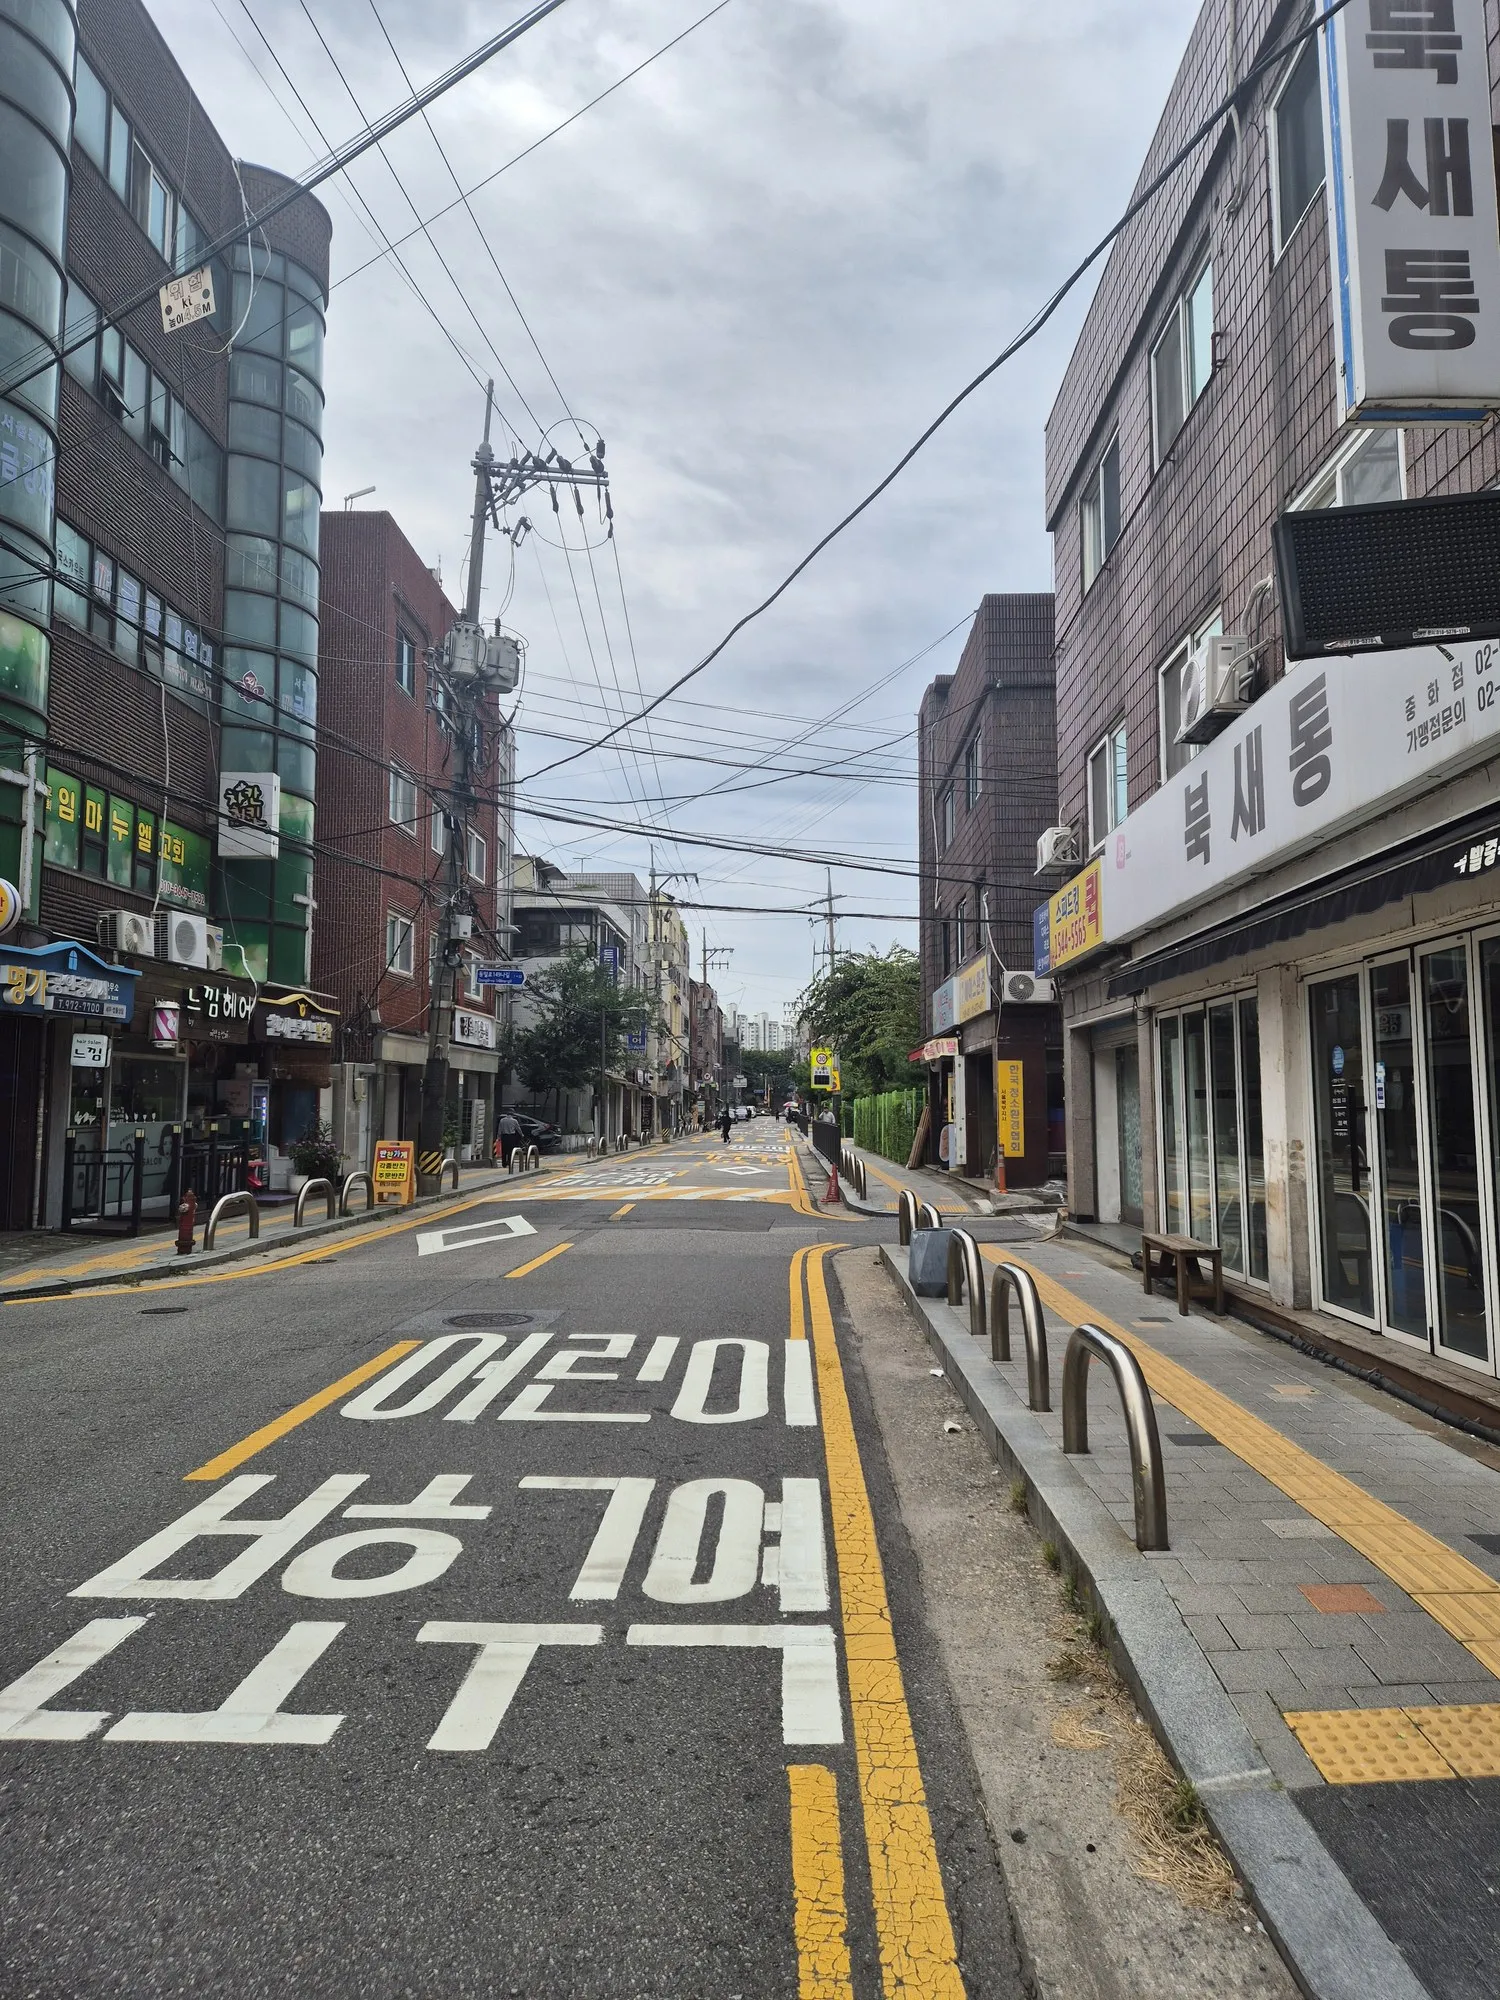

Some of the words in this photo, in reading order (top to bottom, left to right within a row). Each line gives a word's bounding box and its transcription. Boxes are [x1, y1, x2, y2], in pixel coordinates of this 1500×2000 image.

[1365, 0, 1480, 351] 북새통
[170, 272, 203, 300] 위험
[1405, 661, 1464, 721] 중화점
[1406, 697, 1466, 754] 가맹점문의
[1184, 672, 1333, 864] 북새통
[1056, 884, 1080, 924] 스피드킹
[1086, 868, 1099, 938] 퀵
[3, 965, 48, 1006] 명가
[58, 1000, 100, 1013] T.972-7700
[187, 985, 252, 1024] 느낌헤어
[73, 1046, 103, 1062] 느낌
[379, 1150, 408, 1160] 반찬가게
[340, 1332, 817, 1427] 어린이
